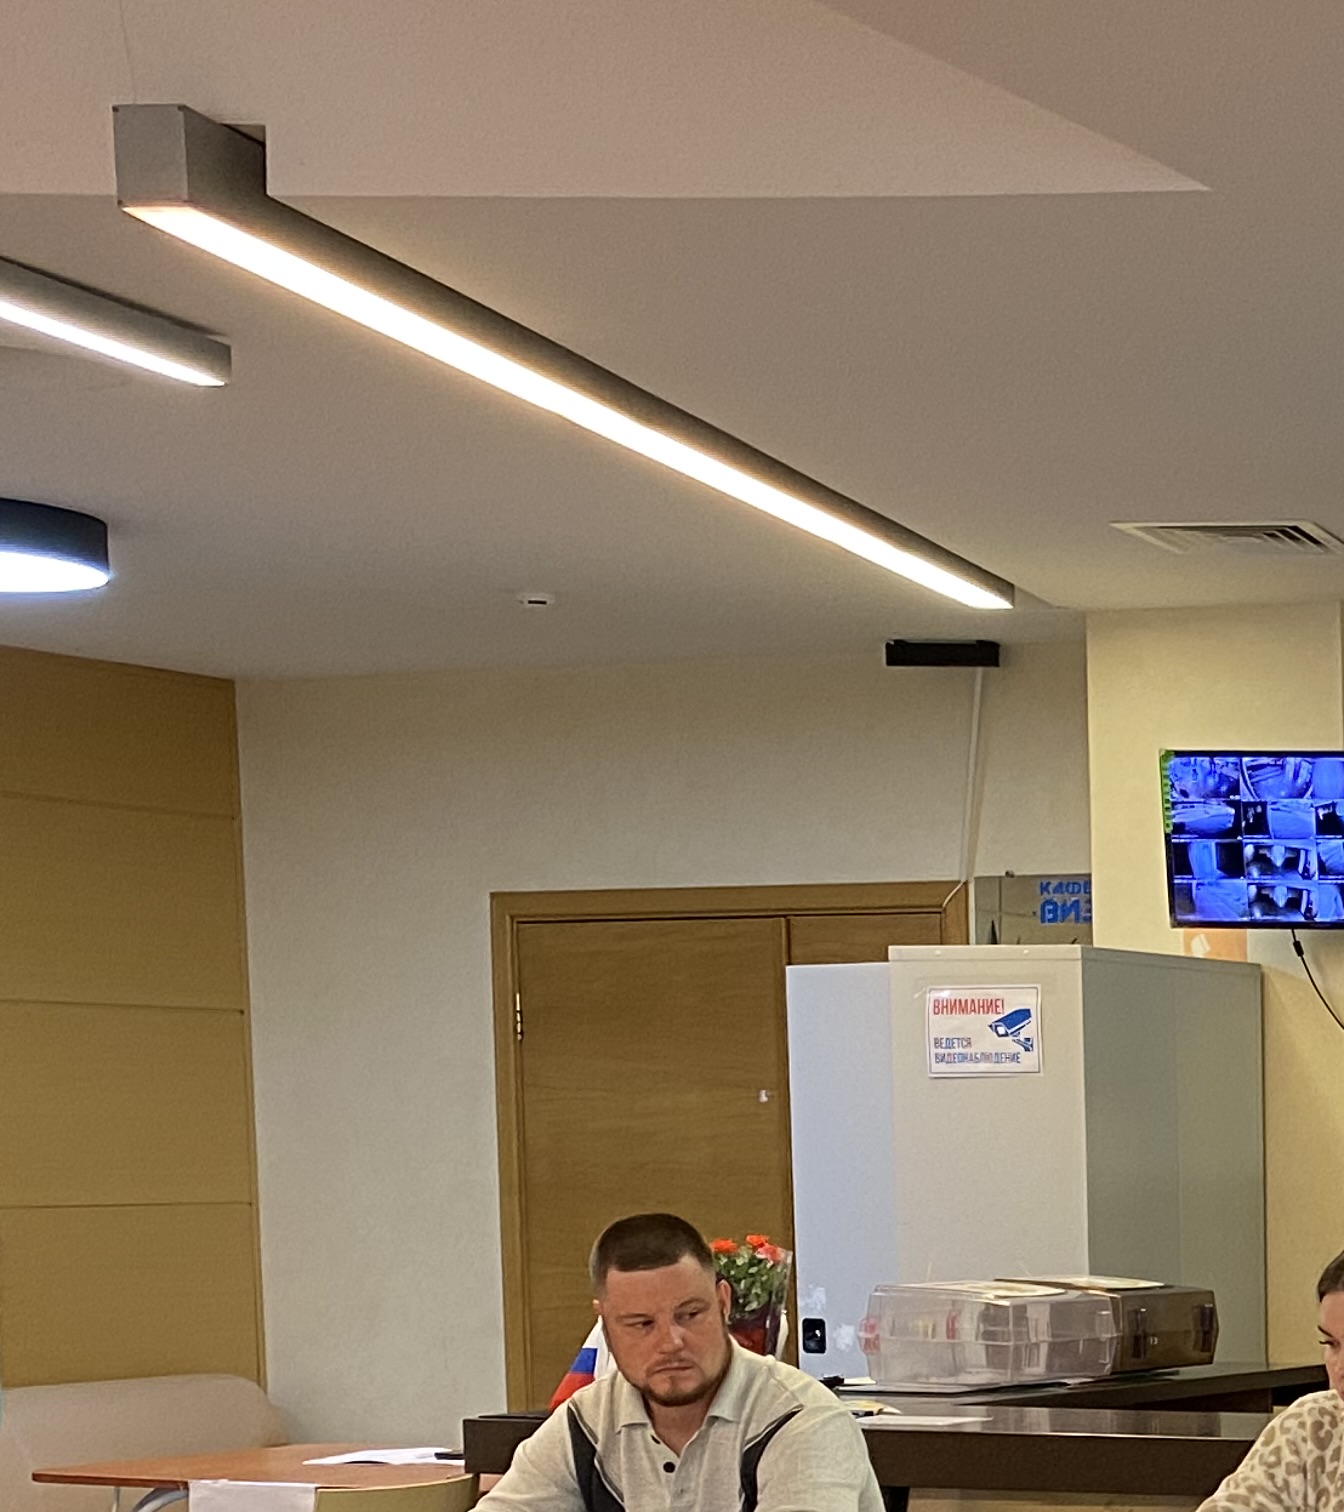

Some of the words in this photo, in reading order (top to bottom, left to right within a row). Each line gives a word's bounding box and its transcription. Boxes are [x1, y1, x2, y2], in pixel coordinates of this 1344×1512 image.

[933, 998, 1005, 1015] ВНИМАНИЕ!
[933, 1037, 972, 1050] ВЕДЕТСЯ
[934, 1051, 1021, 1064] ВИДЕОНАБЛЮДЕНИЕ
